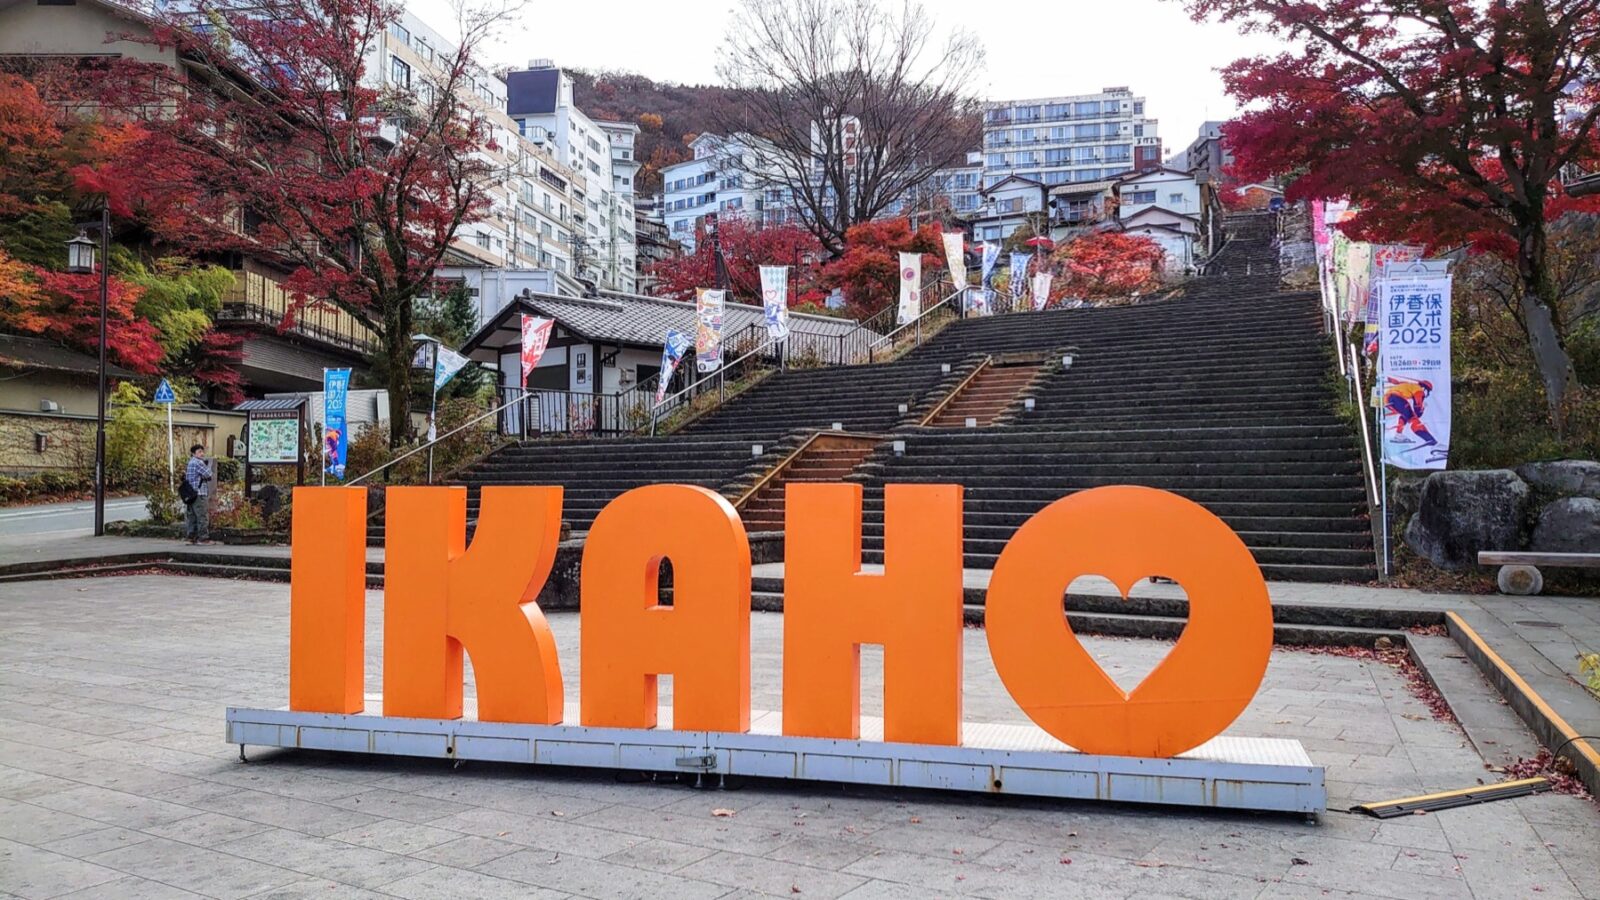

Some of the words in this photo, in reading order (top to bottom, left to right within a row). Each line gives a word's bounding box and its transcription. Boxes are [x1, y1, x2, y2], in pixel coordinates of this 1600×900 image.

[1389, 293, 1443, 311] 伊香保
[1388, 310, 1442, 328] 国スポ
[1389, 328, 1442, 344] 2025
[290, 483, 1273, 758] IKAHO
